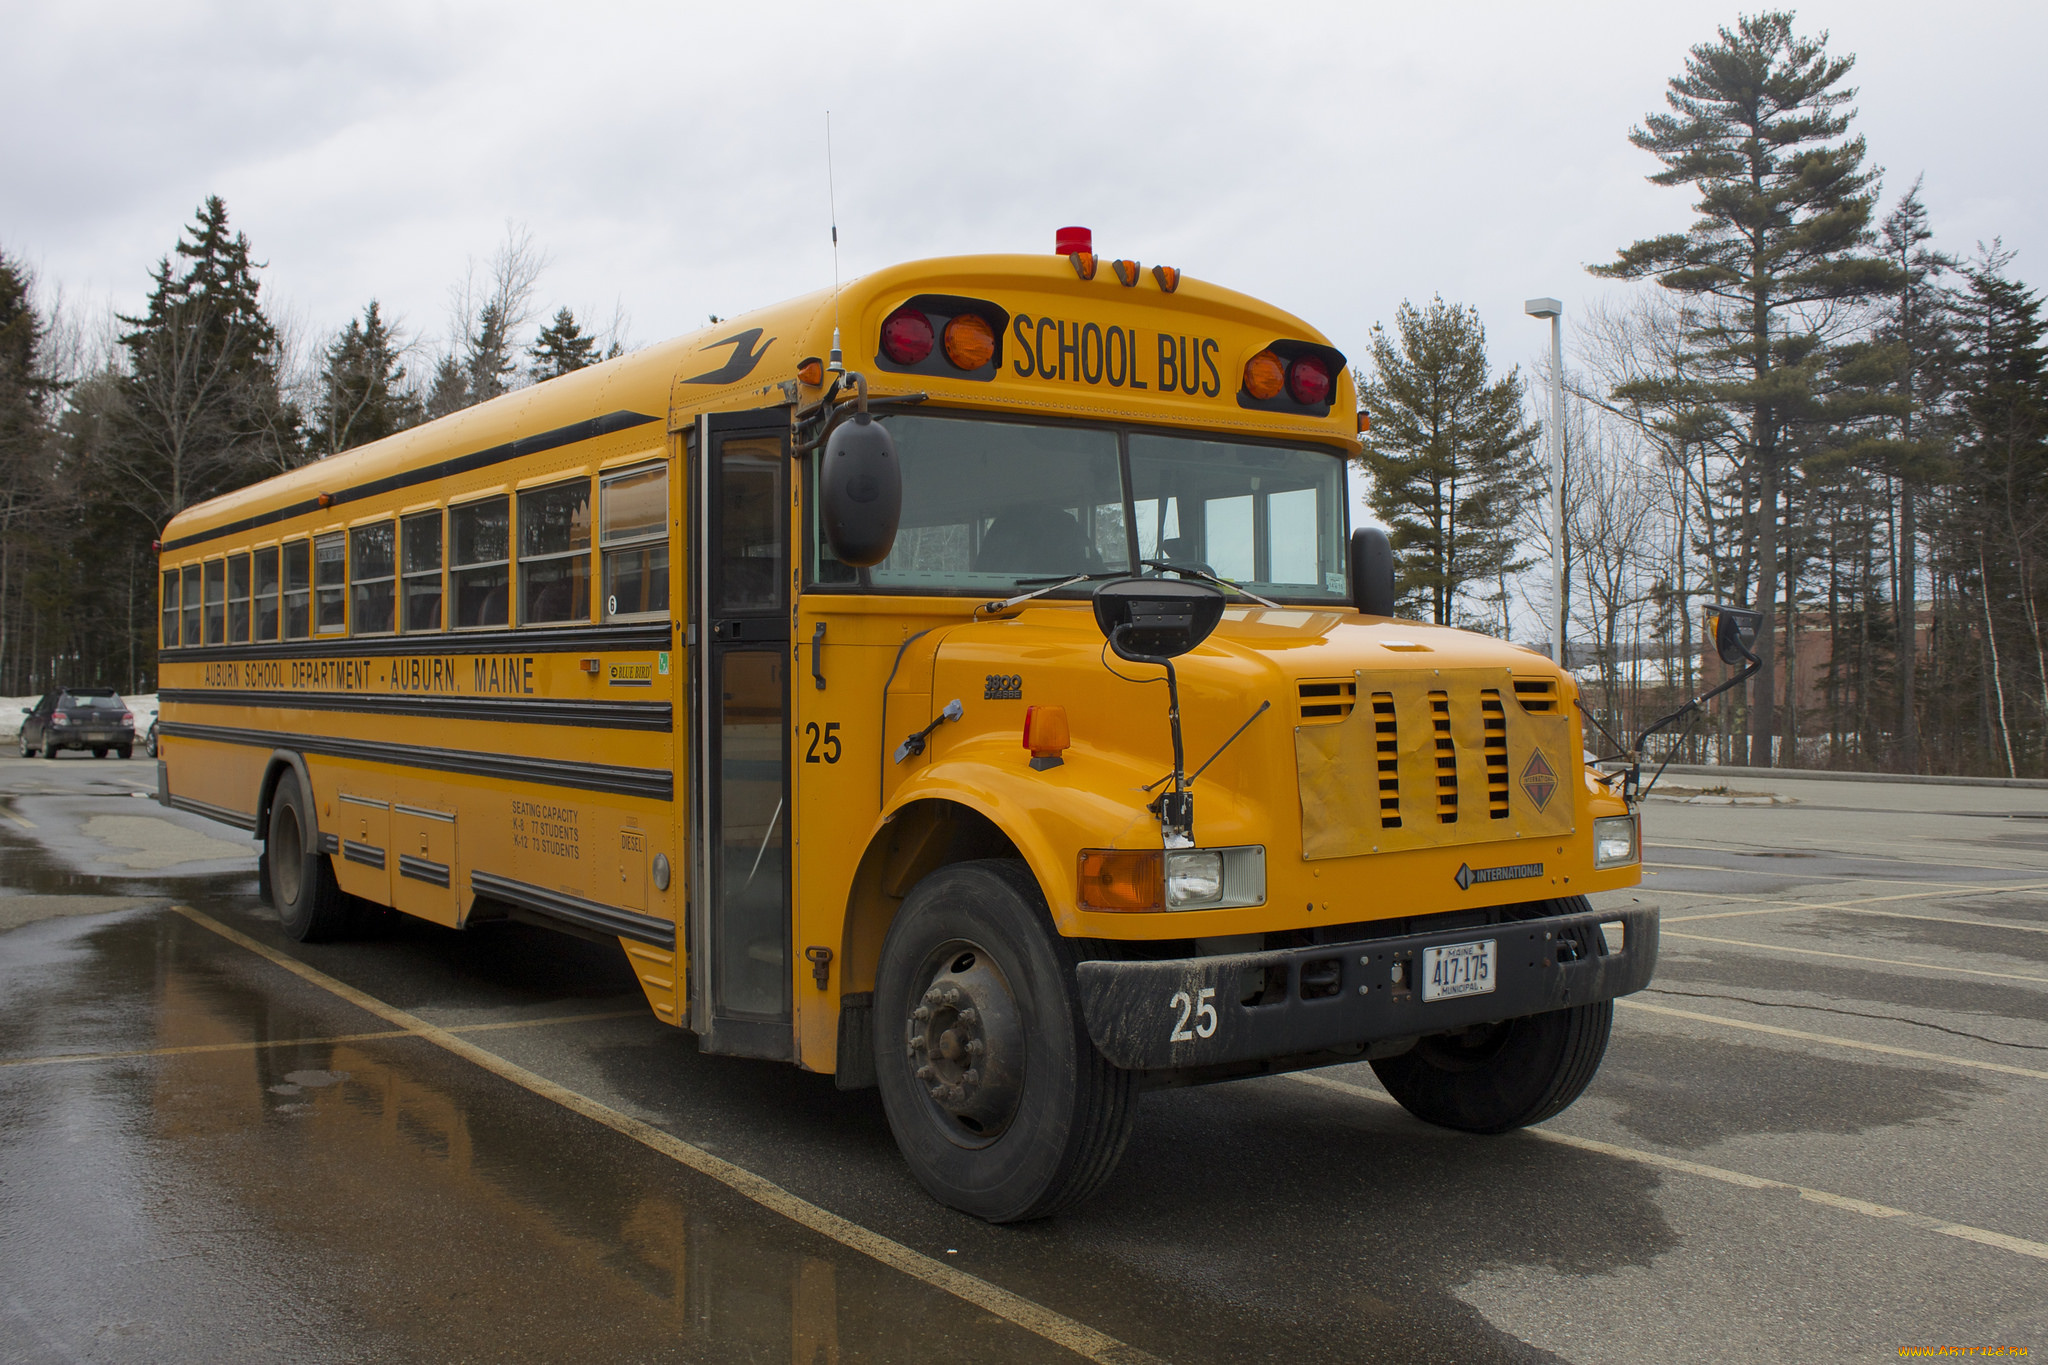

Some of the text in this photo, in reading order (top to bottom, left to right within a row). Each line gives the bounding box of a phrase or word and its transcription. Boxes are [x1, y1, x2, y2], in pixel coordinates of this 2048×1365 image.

[1013, 313, 1221, 398] SCHOOL BUS
[205, 663, 239, 687] AUBURN
[245, 662, 284, 688] SCHOOL
[292, 660, 371, 689] DEPARTMENT
[390, 658, 461, 692] AUBURN,
[474, 657, 534, 694] MAINE
[618, 666, 650, 678] BLUE BIRD
[984, 674, 1022, 691] 3800
[805, 722, 842, 764] 25
[512, 800, 578, 824] SEATING CAPACITY
[531, 820, 539, 834] 77
[540, 822, 579, 842] STUDENTS
[514, 834, 580, 860] K-12 73 STUDENTS
[621, 834, 643, 853] DIESEL
[1476, 863, 1543, 882] INTERNATIONAL
[1448, 947, 1474, 957] MAINE
[1441, 982, 1479, 995] MUNICIPAL
[1169, 987, 1218, 1042] 25
